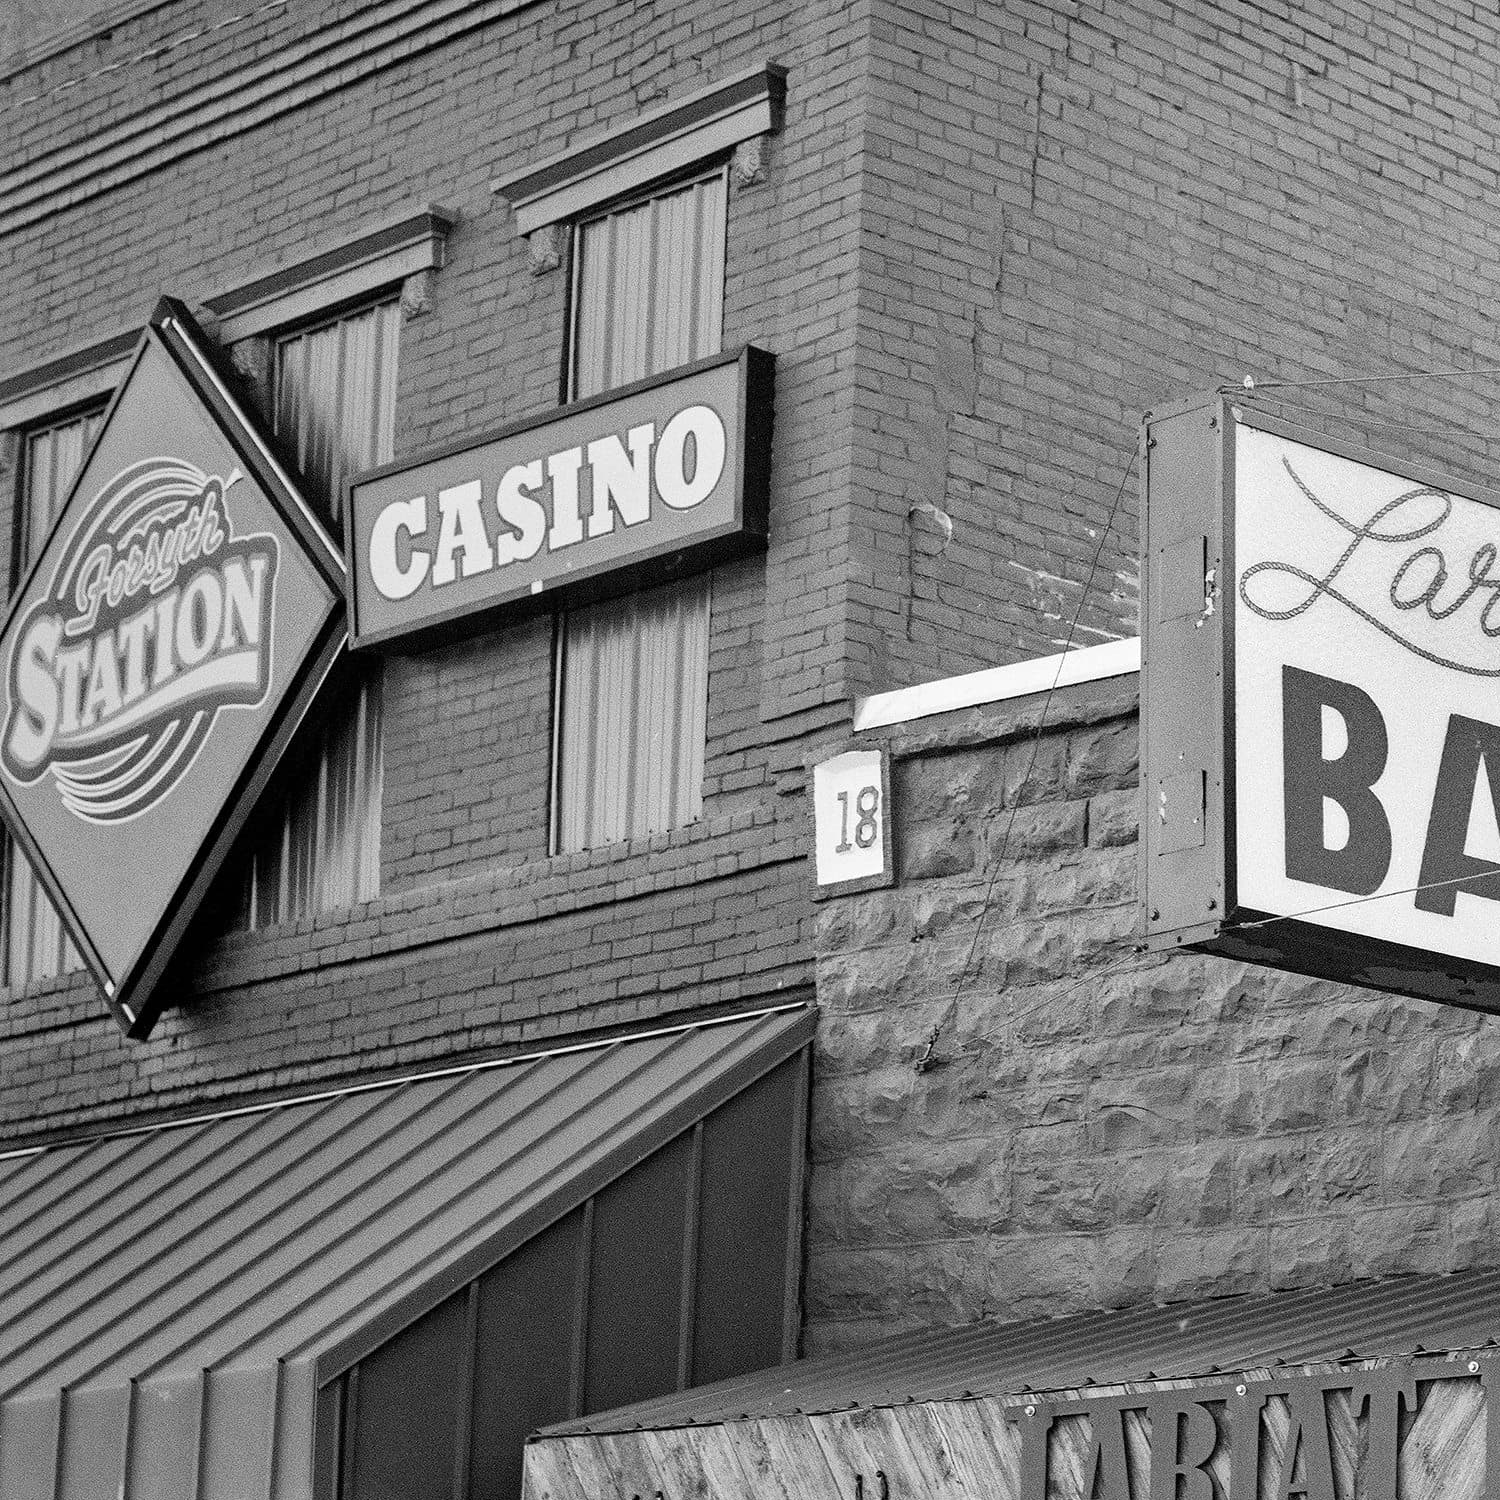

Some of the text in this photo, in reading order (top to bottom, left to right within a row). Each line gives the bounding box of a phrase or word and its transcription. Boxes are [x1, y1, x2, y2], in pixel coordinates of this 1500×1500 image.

[65, 491, 224, 637] Forsyth
[368, 404, 726, 600] CASINO
[9, 553, 266, 768] STATION
[836, 785, 879, 853] 18
